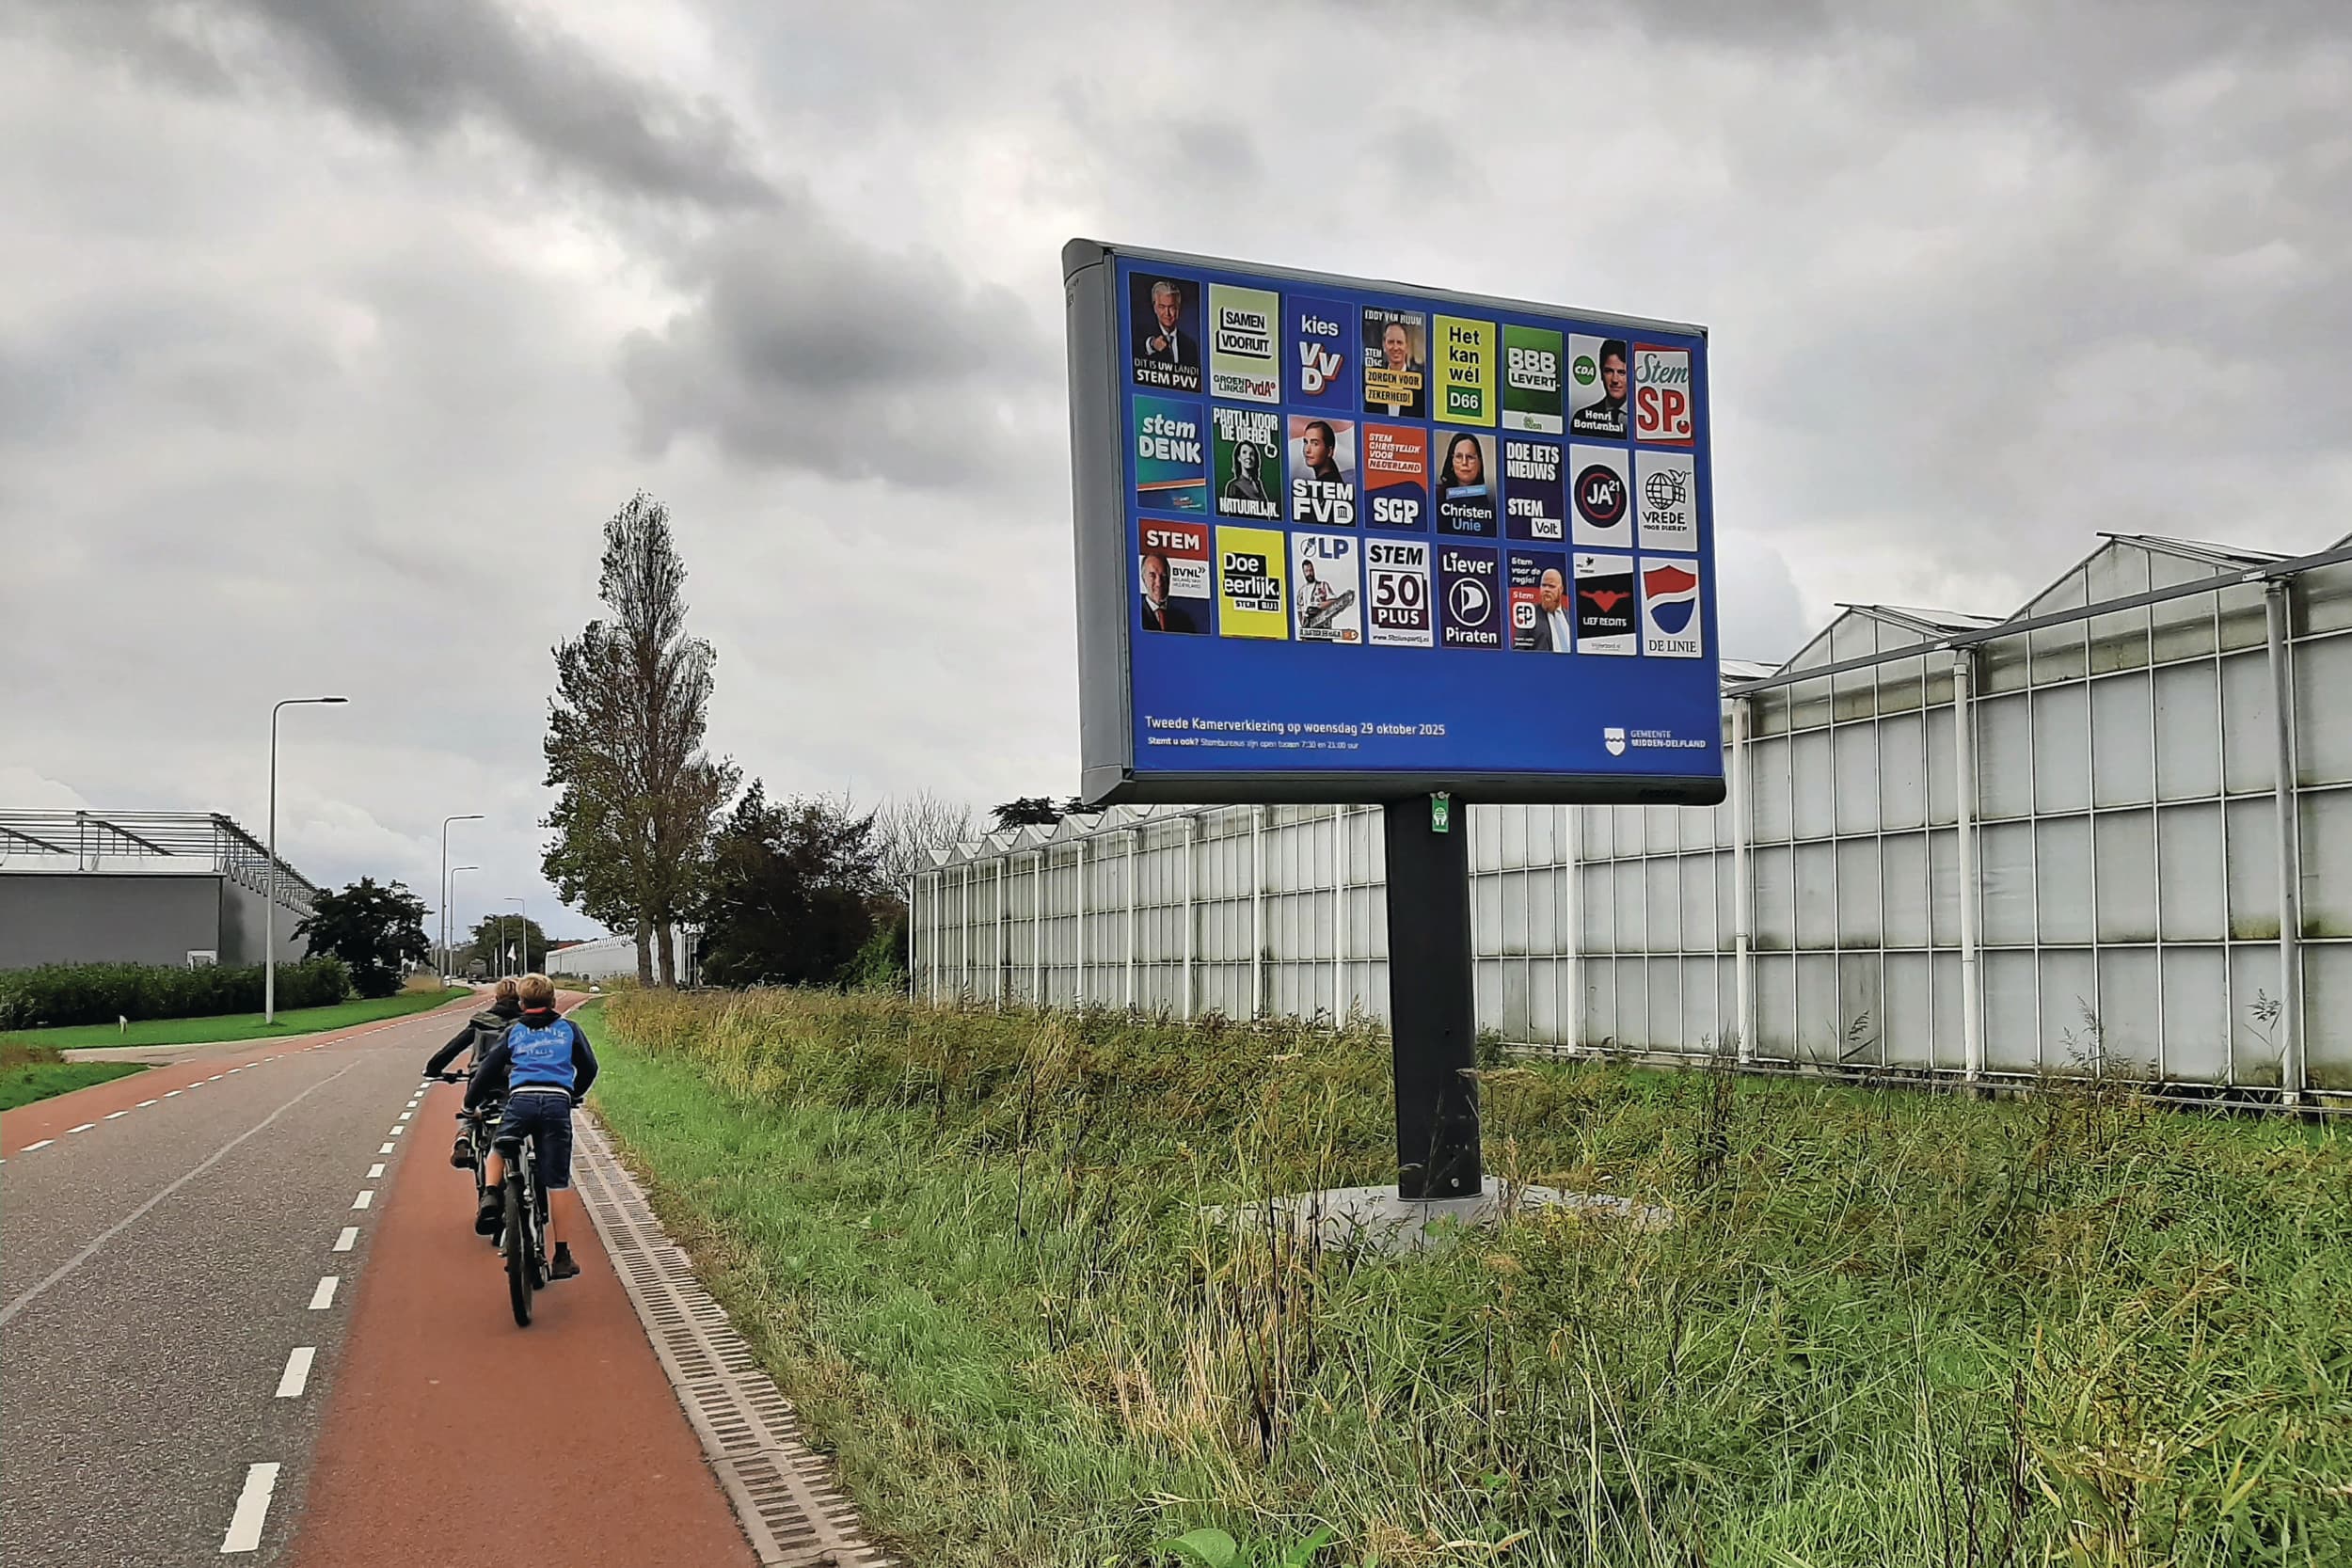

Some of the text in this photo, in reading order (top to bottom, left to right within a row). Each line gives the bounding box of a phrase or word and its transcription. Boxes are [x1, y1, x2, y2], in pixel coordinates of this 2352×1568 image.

[1226, 311, 1264, 328] SAMEN
[1301, 314, 1339, 337] kies
[1384, 311, 1398, 323] VAN
[1221, 334, 1269, 352] VOORUIT
[1449, 326, 1480, 345] Het
[1365, 347, 1382, 358] STEM
[1449, 346, 1479, 364] kan
[1508, 347, 1557, 373] BBB
[1135, 357, 1148, 368] DIT
[1150, 361, 1156, 370] IS
[1158, 361, 1172, 372] UW
[1574, 365, 1595, 377] CDA
[1635, 353, 1688, 385] Stem
[1136, 369, 1198, 388] STEM PVV
[1214, 374, 1244, 385] GROEN
[1368, 371, 1420, 387] ZORGEN VOOR
[1449, 365, 1479, 383] wél
[1218, 383, 1244, 393] LINKS
[1245, 379, 1272, 396] PvdA
[1368, 389, 1410, 403] ZEKERHEID!
[1450, 392, 1479, 409] D66
[1213, 407, 1279, 431] PARTIJ VOOR
[1584, 409, 1612, 420] Henri
[1142, 414, 1196, 438] stem
[1574, 419, 1624, 433] Bontenbal
[1221, 425, 1270, 445] DE DIEREN
[1369, 433, 1392, 442] STEM
[1138, 436, 1201, 464] DENK
[1369, 441, 1421, 453] CHRISTELIJK
[1369, 450, 1393, 460] VOOR
[1506, 442, 1560, 464] DOE IETS
[1369, 460, 1421, 472] NEDERLAND
[1506, 460, 1556, 481] NIEUWS
[1293, 479, 1353, 501] STEM
[1293, 497, 1354, 524] FVD
[1373, 497, 1419, 524] SGP
[1440, 503, 1492, 519] Christen
[1507, 498, 1543, 517] STEM
[1453, 517, 1481, 531] Unie
[1642, 511, 1686, 524] VREDE
[1535, 520, 1558, 534] Volt
[1146, 530, 1200, 550] STEM
[1318, 537, 1349, 560] LP
[1224, 552, 1259, 573] Doe
[1369, 545, 1423, 565] STEM
[1442, 552, 1494, 575] Liever
[1511, 557, 1534, 565] Stem
[1172, 566, 1200, 578] BVNL
[1531, 567, 1541, 576] de
[1224, 576, 1279, 599] eerlijk.
[1376, 575, 1420, 607] 50
[1513, 591, 1534, 599] Stem
[1378, 609, 1420, 625] PLUS
[1445, 627, 1497, 643] Piraten
[1648, 640, 1697, 653] DE LINIE
[1144, 716, 1446, 736] Tweede Kamerverkiezing op woensdag 29 oktober 2025
[1148, 737, 1170, 746] Stemt
[1180, 737, 1199, 746] ook?
